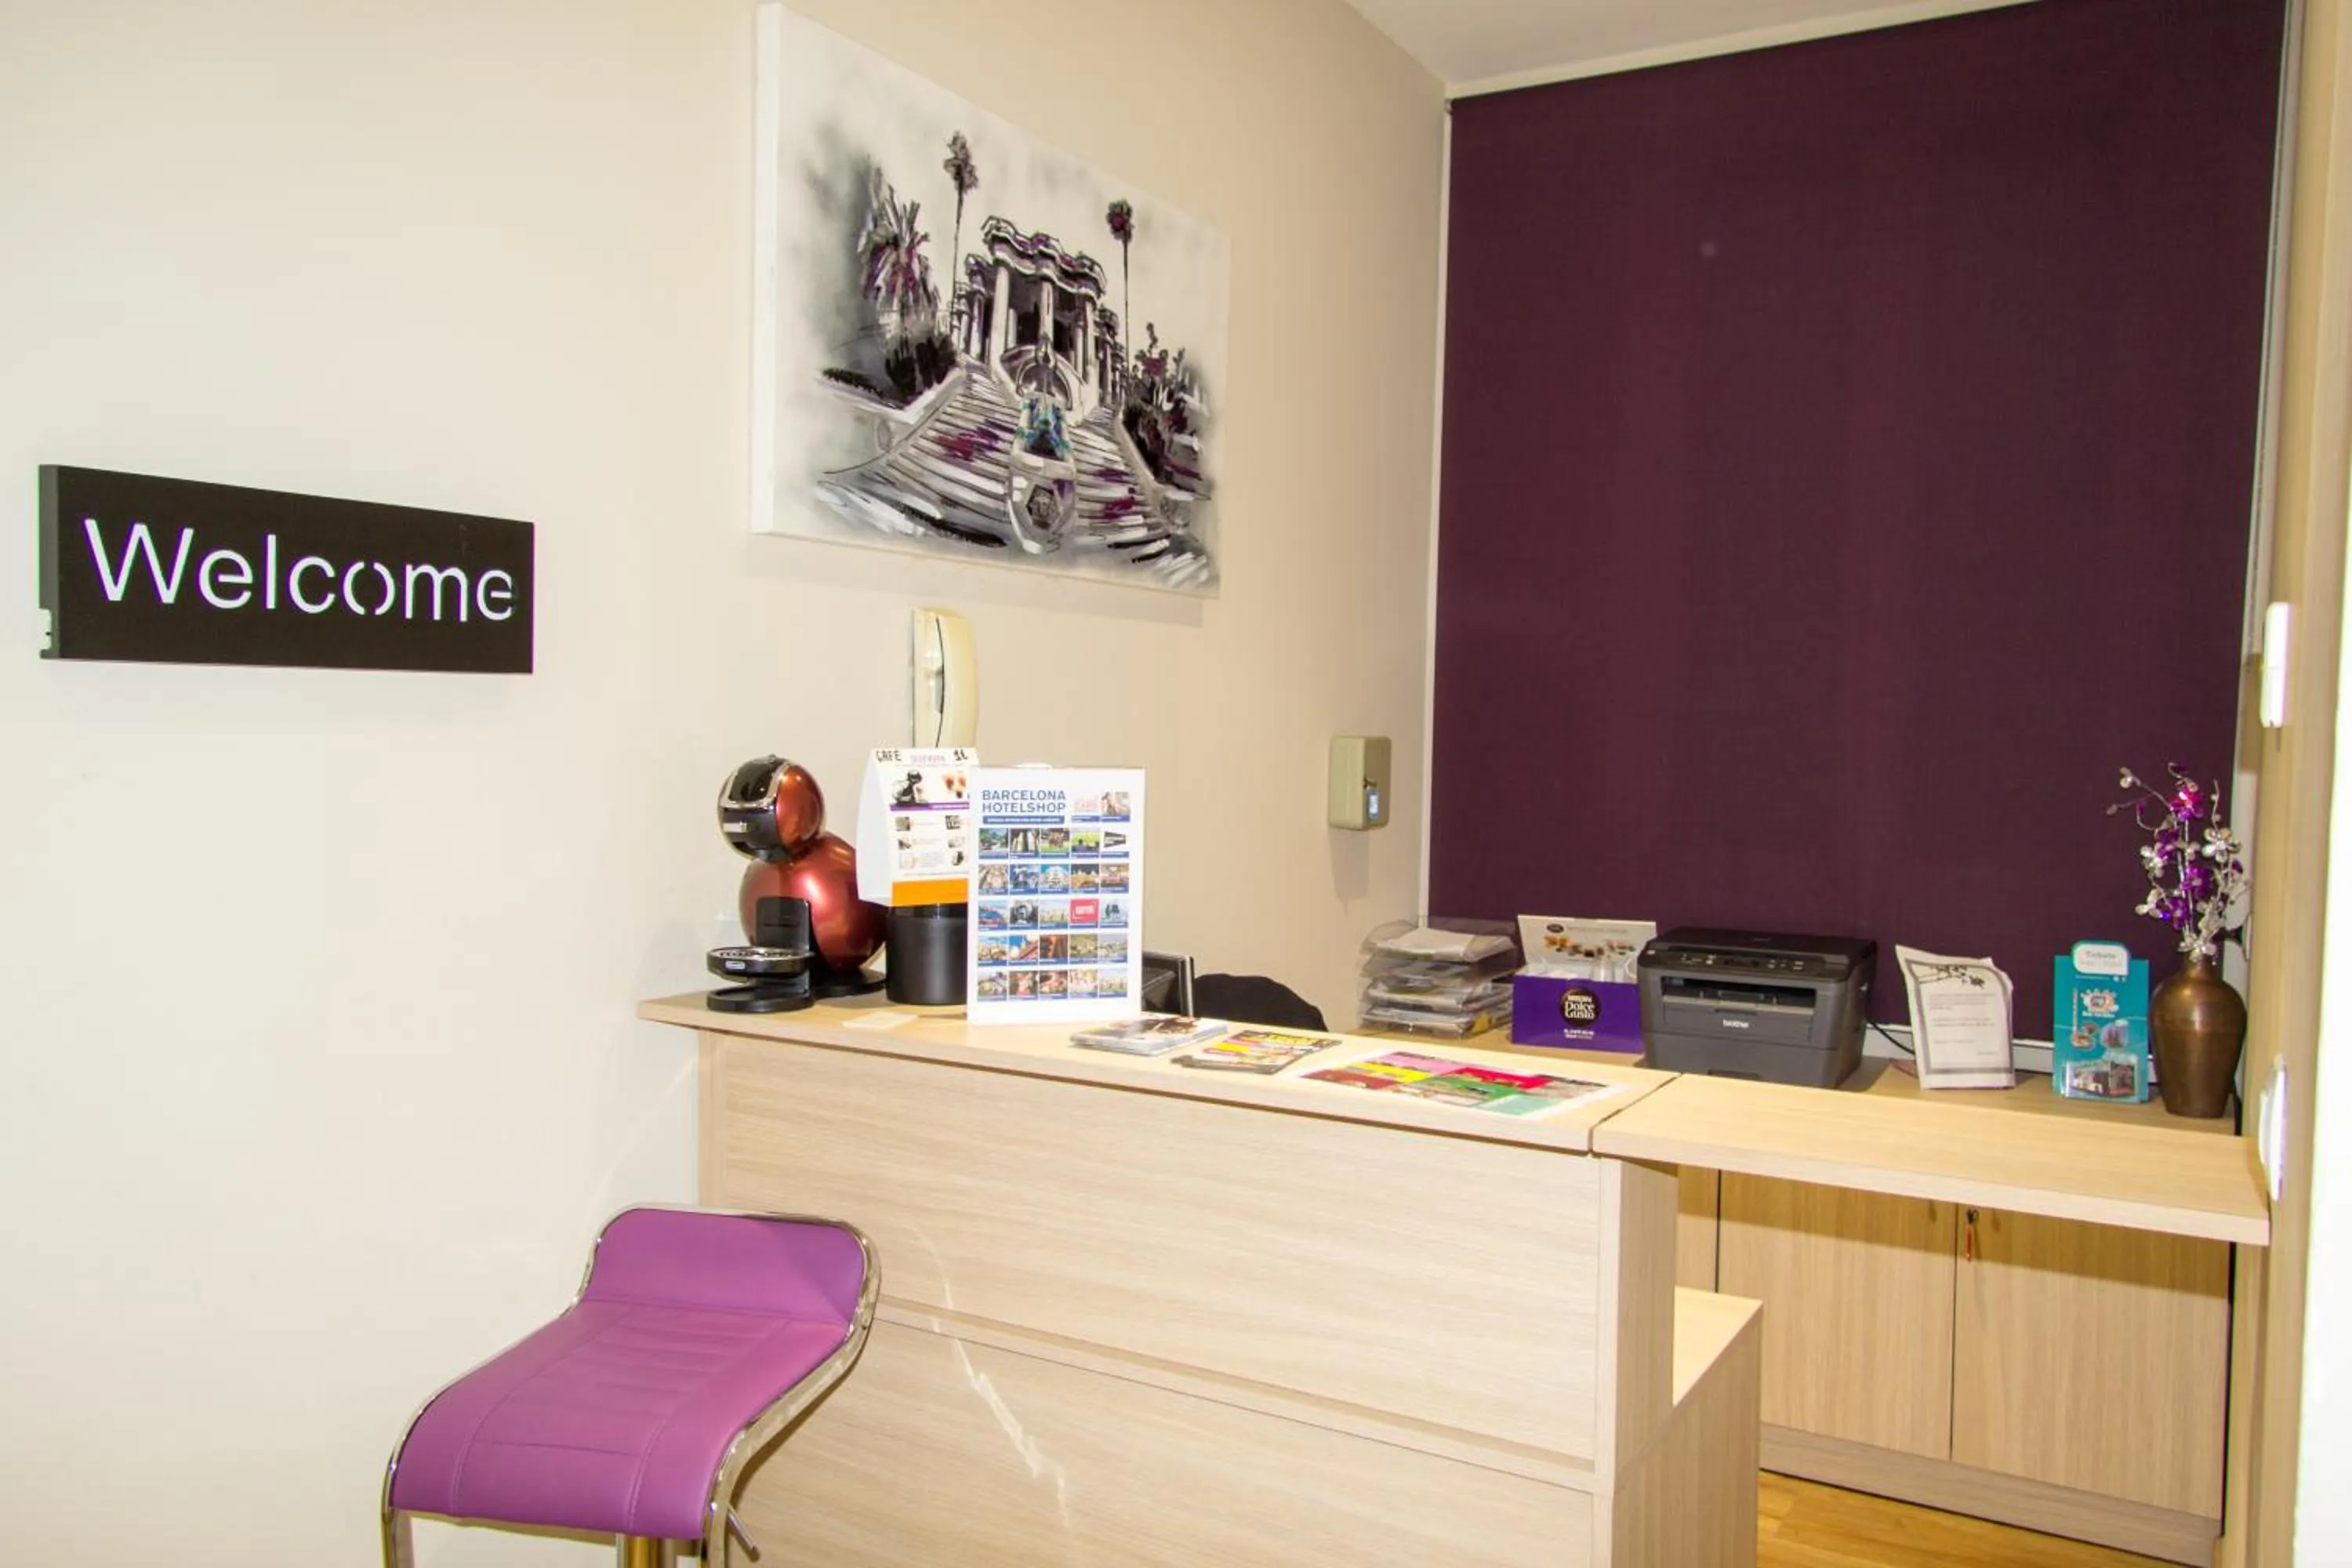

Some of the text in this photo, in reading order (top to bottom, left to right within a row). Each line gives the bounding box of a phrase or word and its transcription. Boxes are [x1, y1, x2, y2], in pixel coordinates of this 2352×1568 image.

[84, 517, 514, 622] Welcome
[982, 789, 1066, 800] BARCELONA
[982, 802, 1066, 813] HOTELSHOP
